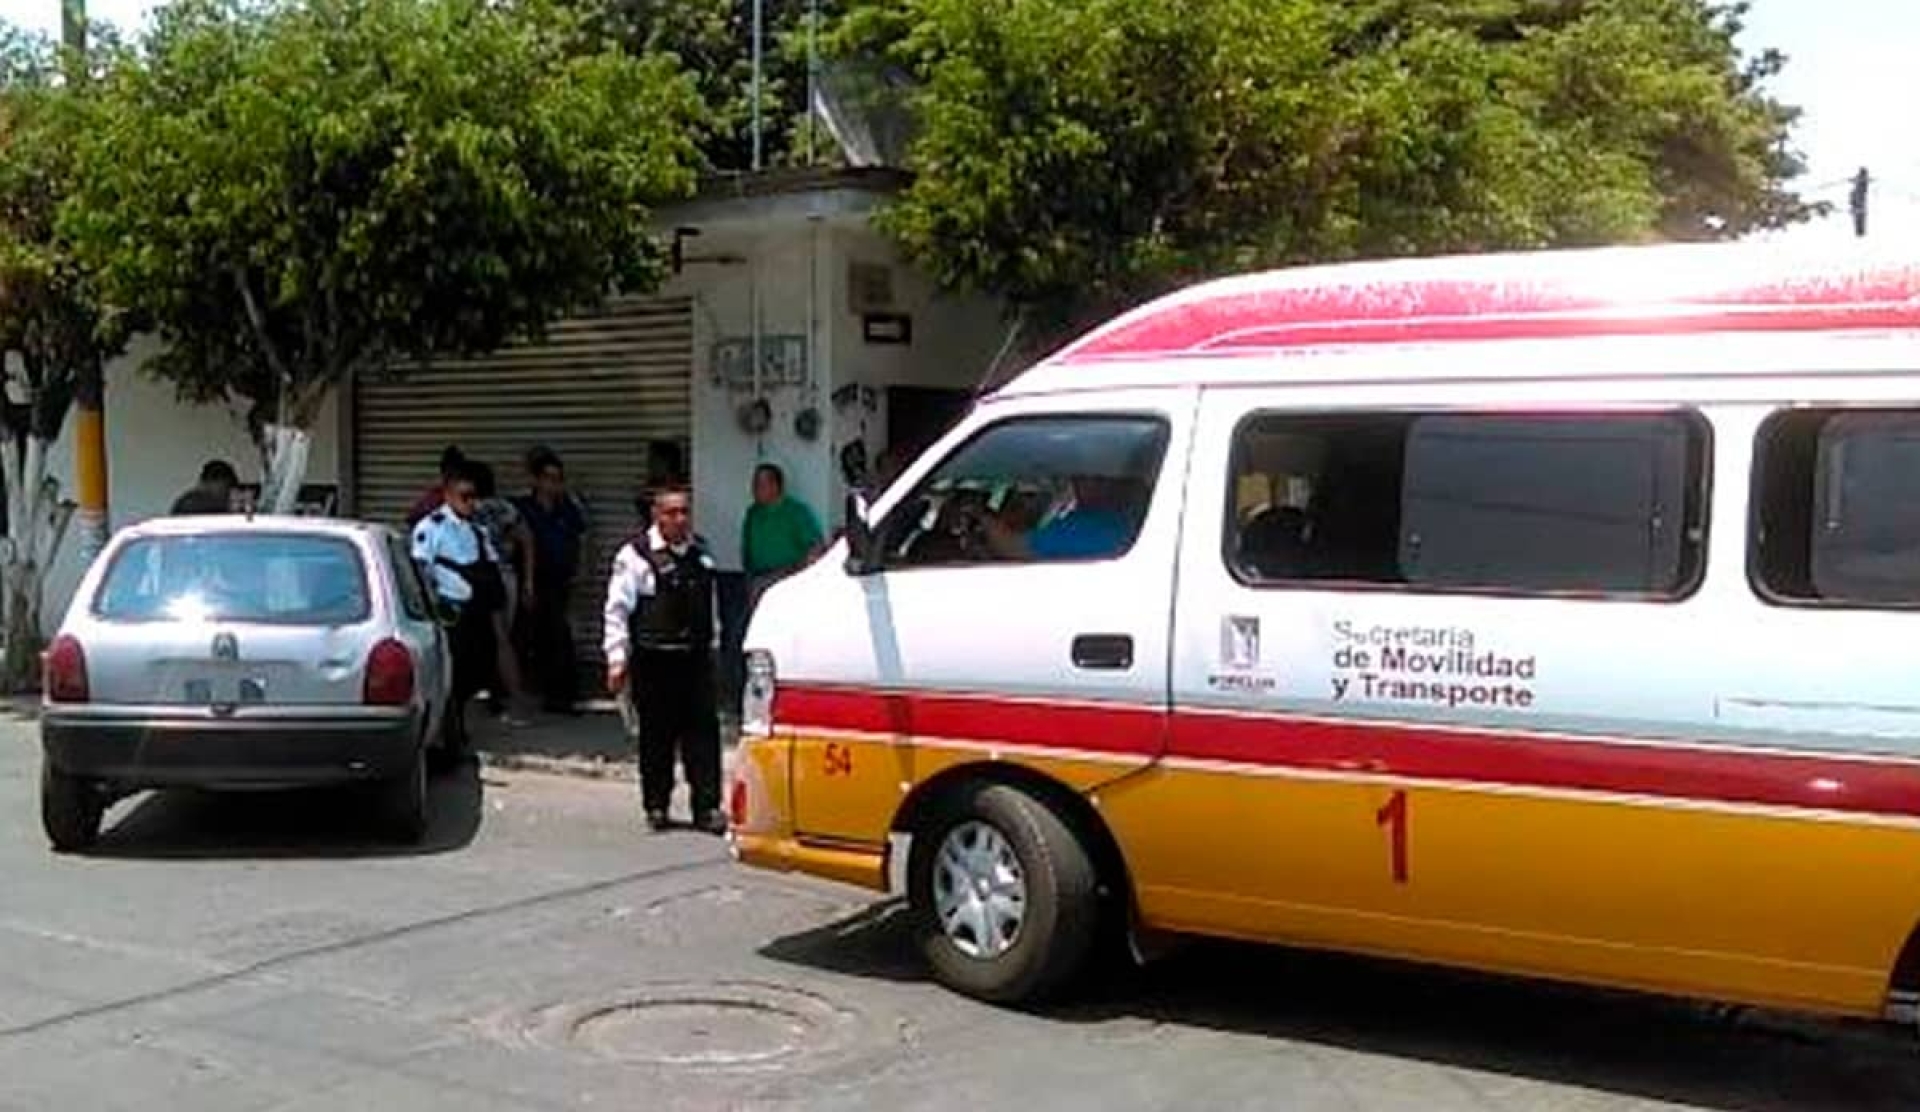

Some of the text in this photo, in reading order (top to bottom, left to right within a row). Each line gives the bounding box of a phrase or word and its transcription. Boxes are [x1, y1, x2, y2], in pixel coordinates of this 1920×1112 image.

[1333, 646, 1536, 679] de Movilidad
[1331, 673, 1535, 708] y Transporte
[823, 742, 851, 776] 54
[1376, 789, 1407, 884] 1
